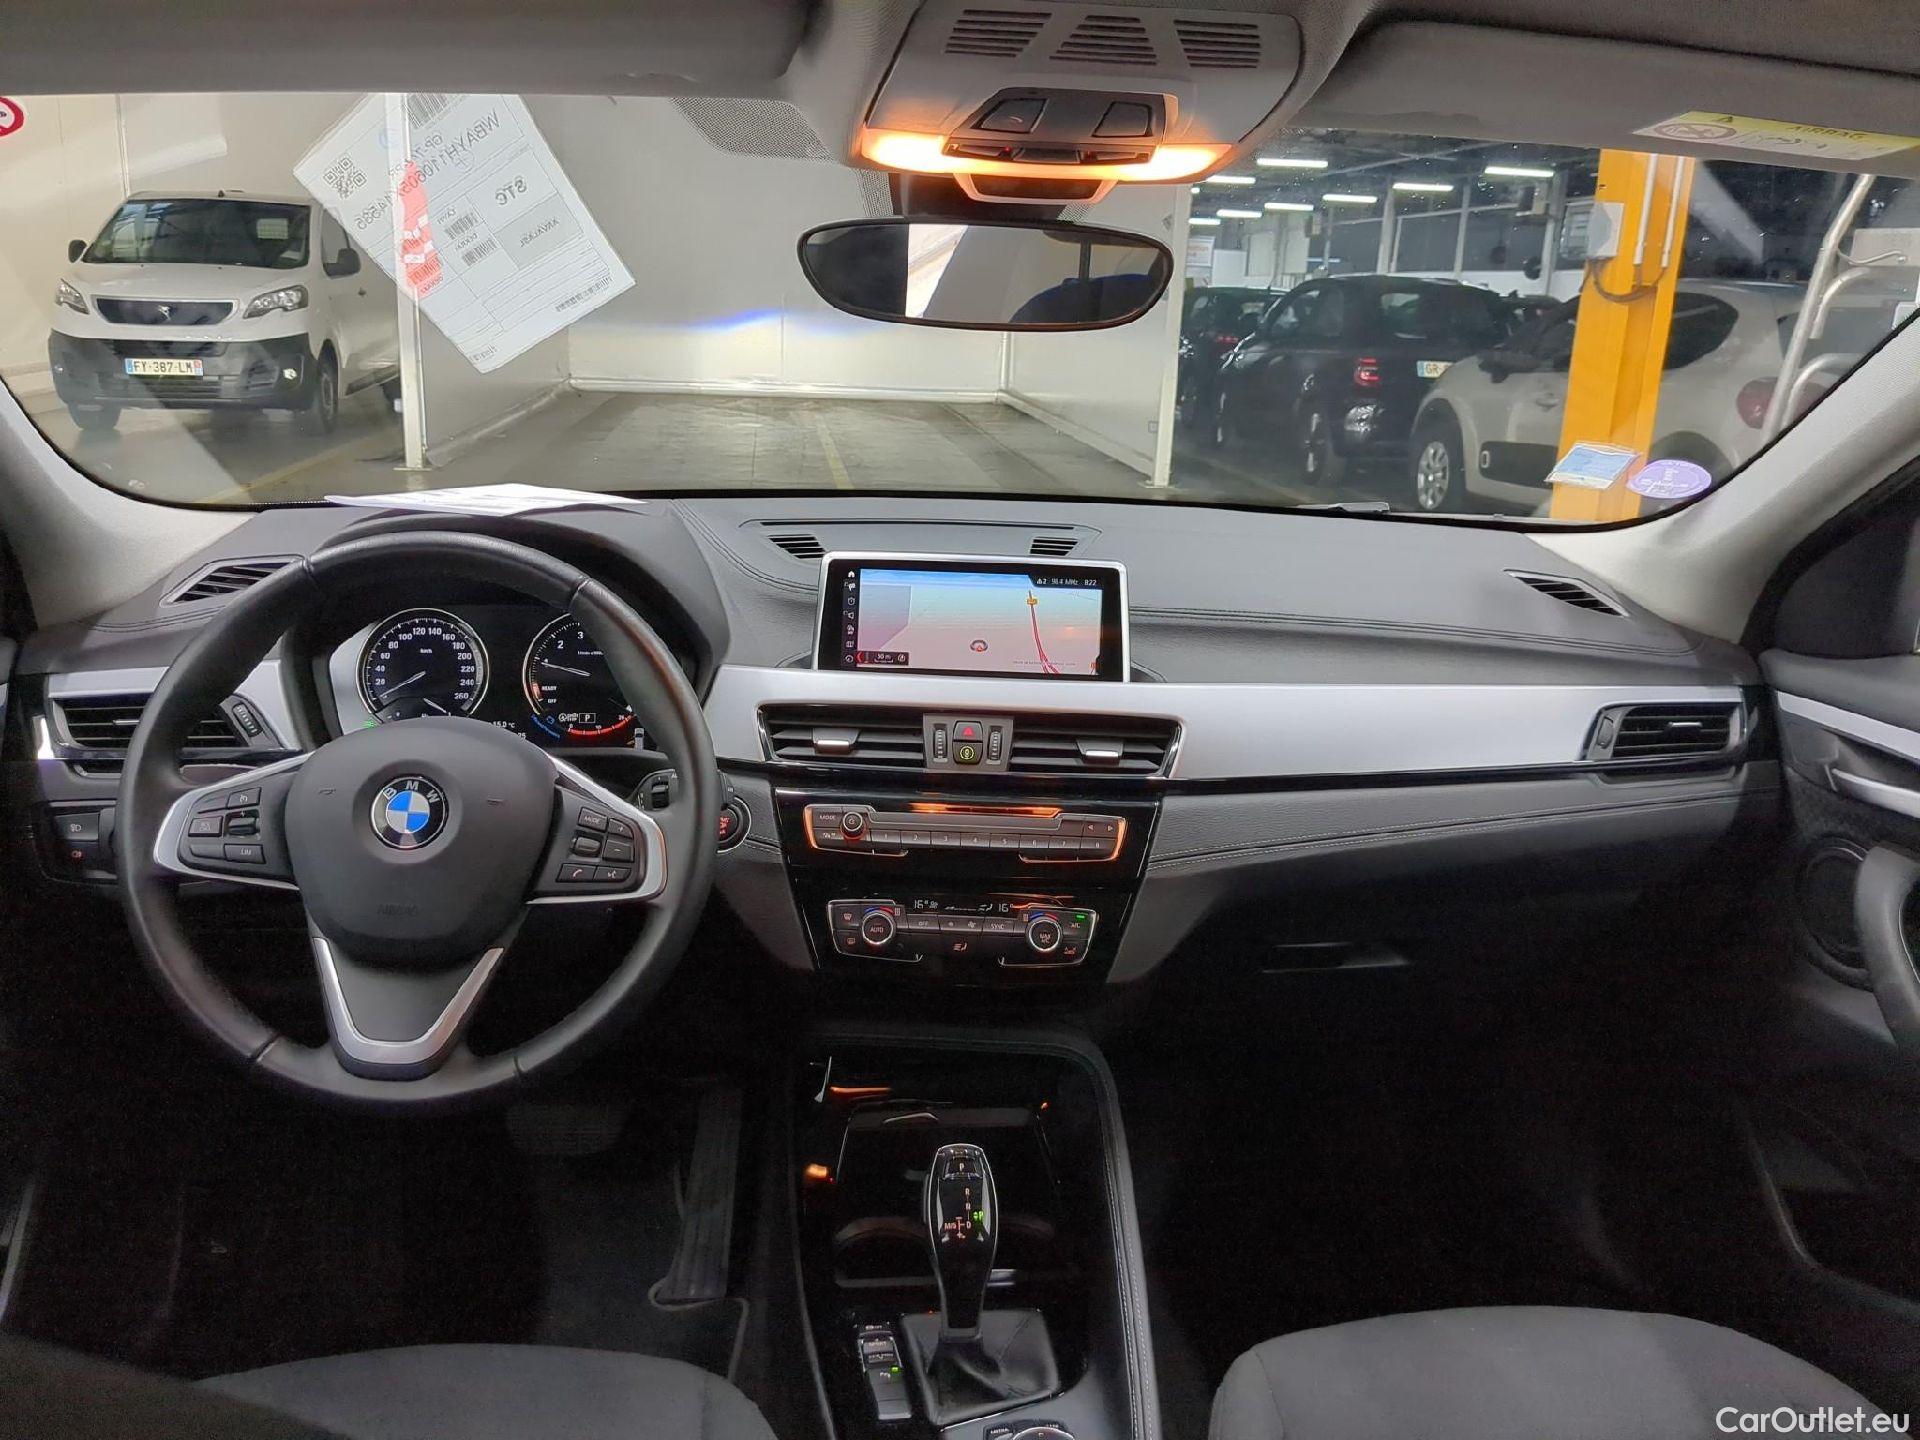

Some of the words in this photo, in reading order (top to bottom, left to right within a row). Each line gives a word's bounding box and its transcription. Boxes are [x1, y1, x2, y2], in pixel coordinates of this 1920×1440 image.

[134, 360, 193, 373] FY-387-LM
[413, 628, 425, 636] 120
[428, 628, 442, 636] 140
[388, 641, 398, 649] 80
[453, 642, 465, 650] 180
[558, 640, 564, 649] 2
[382, 780, 442, 804] BMW
[959, 1163, 964, 1171] P
